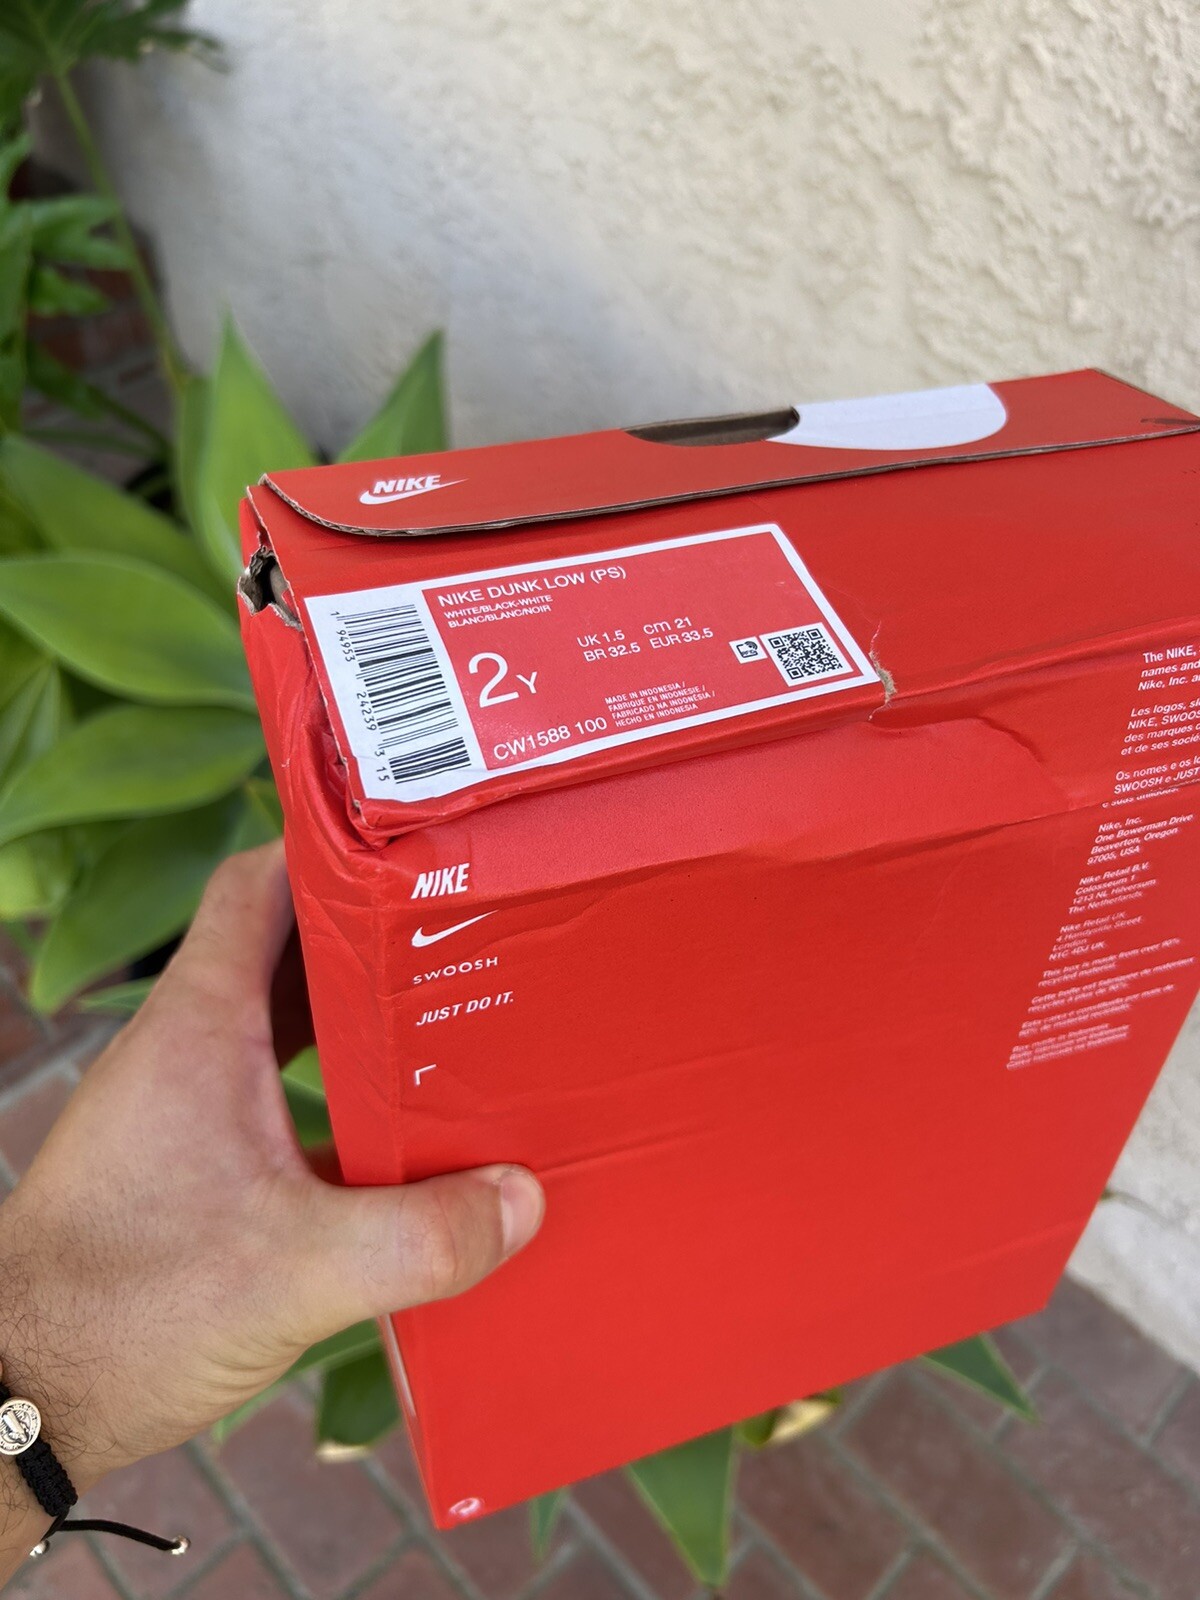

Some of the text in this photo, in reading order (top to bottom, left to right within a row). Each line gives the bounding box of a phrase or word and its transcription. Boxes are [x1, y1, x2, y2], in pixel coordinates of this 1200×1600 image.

[373, 474, 441, 494] NIKE
[437, 566, 627, 607] NIKE DUNK LOW (PS)
[444, 594, 553, 619] WHITE/BLACK-WHITE
[448, 604, 551, 628] BLANC/BLANC/NOIR
[577, 616, 692, 648] UK 1.5 cm 21
[583, 627, 713, 662] BR 32.5 EUR 33.5
[1143, 645, 1197, 664] The NIKE,
[336, 629, 356, 662] 94953
[356, 692, 377, 731] 24239
[1141, 664, 1178, 678] names
[605, 693, 628, 705] MADE
[629, 691, 638, 699] IN
[639, 682, 681, 697] INDONESIA
[1138, 680, 1165, 691] Nike,
[1168, 676, 1188, 686] Inc.
[608, 698, 646, 712] FABRIQUE
[647, 694, 659, 703] EN
[611, 705, 655, 719] FABRICADO
[656, 701, 668, 709] NA
[1131, 707, 1151, 718] Les
[1153, 702, 1187, 714] logos,
[615, 703, 699, 727] HECHO EN INDONESIA
[493, 717, 607, 760] CW1588 100
[1124, 733, 1144, 743] des
[1147, 724, 1193, 739] marques
[1120, 746, 1132, 756] et
[1134, 744, 1148, 753] de
[1150, 741, 1169, 750] ses
[1114, 776, 1164, 794] SWOOSH
[1173, 766, 1200, 781] JUST
[1115, 770, 1130, 781] Os
[1133, 764, 1168, 778] nomes
[1170, 762, 1177, 770] e
[1179, 759, 1191, 768] os
[1091, 827, 1178, 854] Beaverton, Oregon
[1095, 814, 1194, 844] One Bowerman Drive
[1120, 845, 1141, 857] USA
[411, 862, 470, 900] NIKE
[1075, 877, 1128, 895] Colosseum
[1079, 875, 1101, 885] Nike
[1103, 866, 1131, 880] Retail
[1068, 905, 1086, 914] The
[413, 956, 498, 985] SWOOSH
[416, 990, 514, 1026] JUST DO IT.
